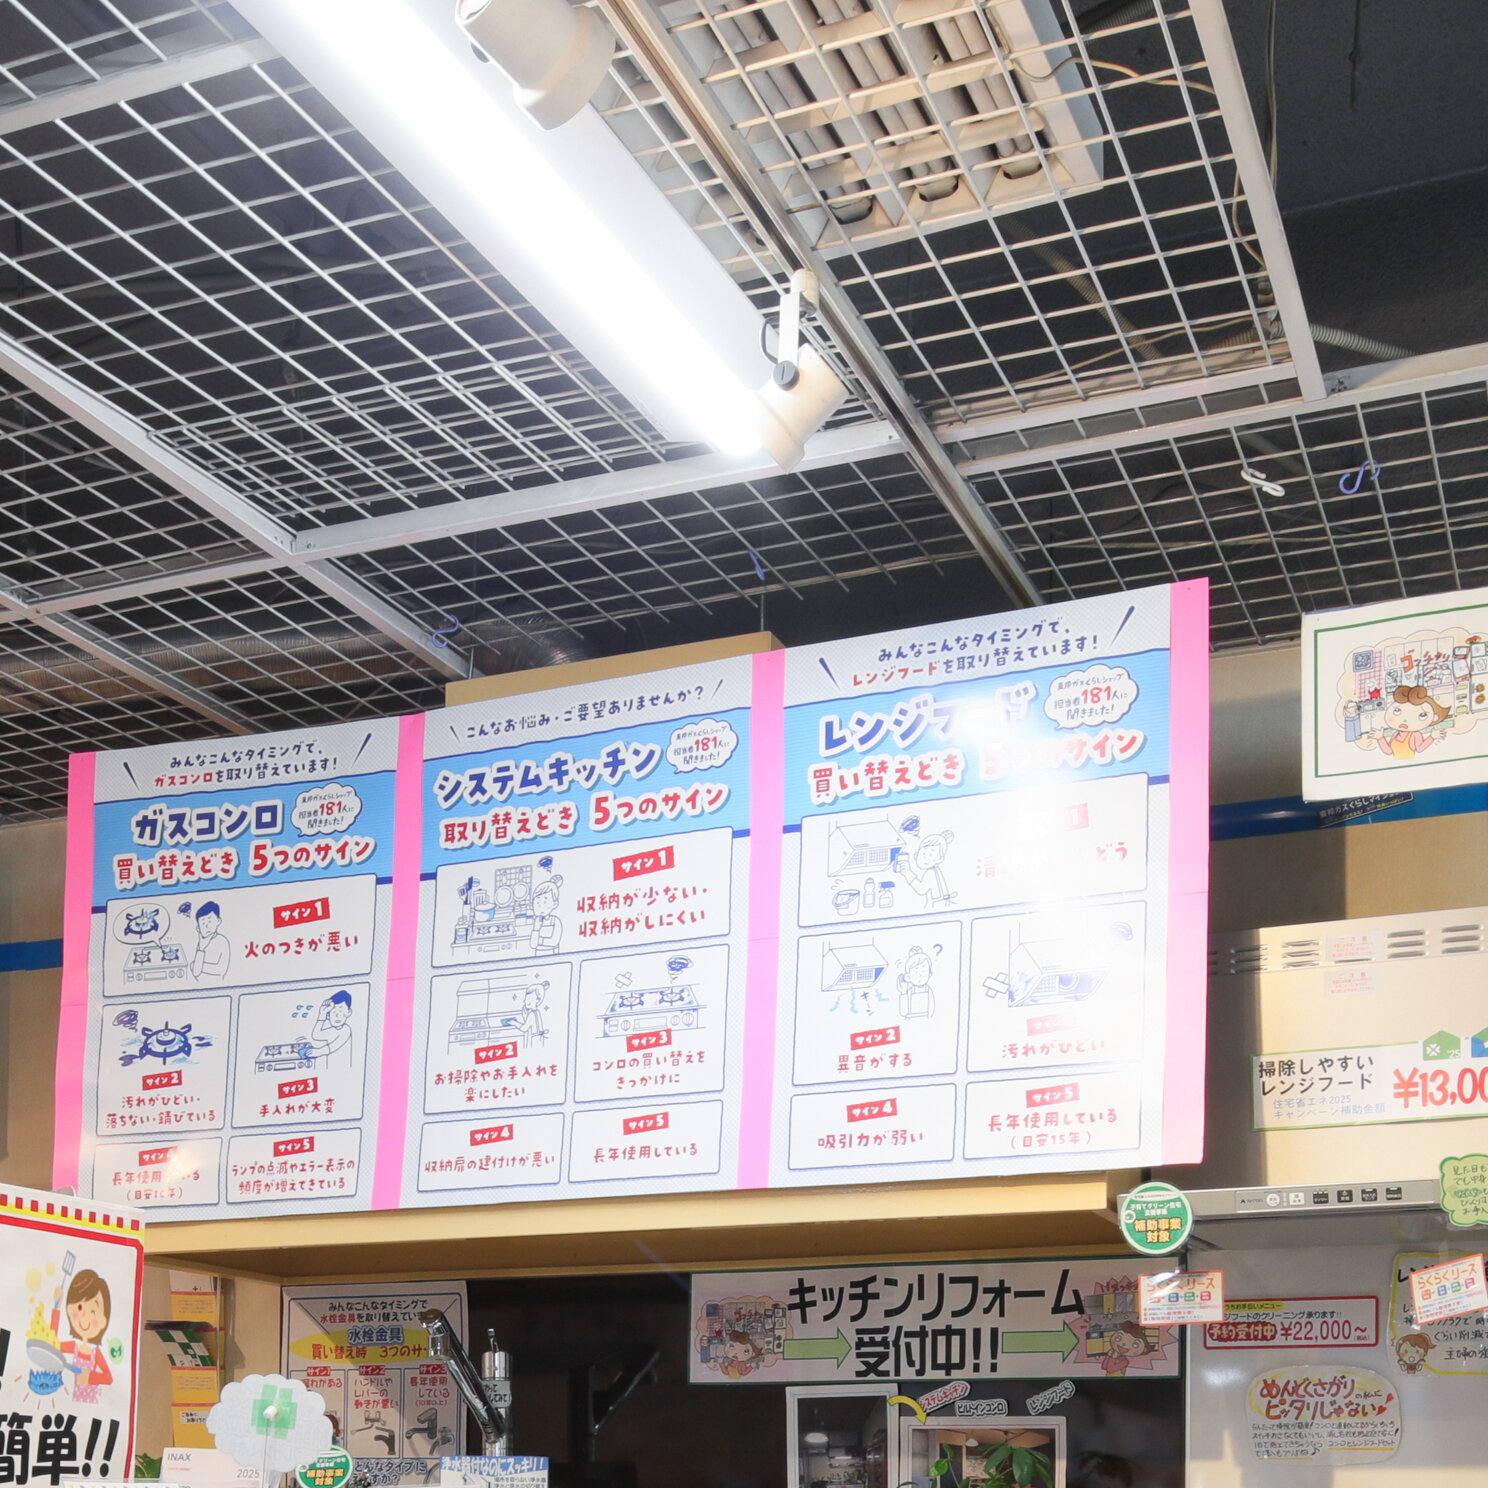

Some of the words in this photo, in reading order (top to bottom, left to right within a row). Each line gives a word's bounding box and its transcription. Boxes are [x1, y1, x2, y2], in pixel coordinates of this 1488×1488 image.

[878, 616, 1071, 662] みんなこんなタイミングで、
[852, 635, 1098, 687] レンジフードを取り替えています!
[466, 686, 703, 740] こんなお悩み・ご要望ありませんか?
[170, 739, 324, 768] みんなこんなタイミングで、
[155, 757, 338, 788] ガスコンロを取り替えています!
[437, 746, 656, 802] システムキッチン
[812, 753, 960, 798] 買い替えどき
[134, 802, 280, 842] ガスコンロ
[444, 806, 573, 843] 取り替えどき
[594, 787, 723, 825] 5つのサイン
[116, 851, 235, 884] 買い替えどき
[252, 840, 371, 871] 5つのサイン
[621, 850, 668, 873] サイン1
[579, 910, 705, 938] 収納がしにくい
[244, 931, 359, 958] 火のつきが悪い
[631, 1031, 668, 1047] サイン3
[855, 1028, 897, 1045] サイン2
[478, 1044, 514, 1060] サイン2
[1002, 1040, 1105, 1059] 汚れがひどい
[593, 1051, 706, 1072] コンロの買い替えを
[837, 1053, 912, 1073] 異音がする
[1258, 1054, 1374, 1080] 掃除しやすい
[434, 1063, 558, 1085] お掃除やお手入れを
[616, 1073, 680, 1090] きっかけに
[464, 1086, 525, 1102] 楽にしたい
[1261, 1073, 1373, 1097] レンジフード
[259, 1098, 335, 1116] 手入れが大変
[851, 1101, 893, 1117] サイン4
[1272, 1094, 1352, 1110] 住宅省エネ2025
[1273, 1102, 1386, 1119] キャンペーン補助金額
[628, 1114, 665, 1131] サイン5
[987, 1109, 1118, 1132] 長年使用している
[474, 1126, 510, 1142] サイン4
[818, 1129, 924, 1150] 吸引力が弱い
[278, 1139, 310, 1154] サイン5
[593, 1142, 698, 1163] 長年使用している
[232, 1159, 355, 1177] ランプの点滅やエラー表示の
[424, 1151, 555, 1174] 収納扉の建付けが悪い
[1134, 1218, 1183, 1232] 補助事業
[1145, 1230, 1171, 1243] 対象
[1417, 1263, 1478, 1290] らくらくリース
[328, 1299, 428, 1311] みんなこんなタイミングで
[787, 1269, 1086, 1324] キッチンリフォーム
[348, 1326, 404, 1343] 水栓金具
[1208, 1322, 1277, 1341] 予約受付中
[311, 1343, 367, 1360] 買い替え時
[854, 1324, 999, 1378] 受付中!!
[354, 1378, 393, 1387] ハンドルや
[410, 1377, 448, 1386] 長年使用
[354, 1389, 389, 1398] レバーの
[418, 1388, 451, 1398] している
[1028, 1383, 1074, 1414] レンジフード
[166, 1452, 192, 1463] INAX
[236, 1468, 260, 1479] 2025
